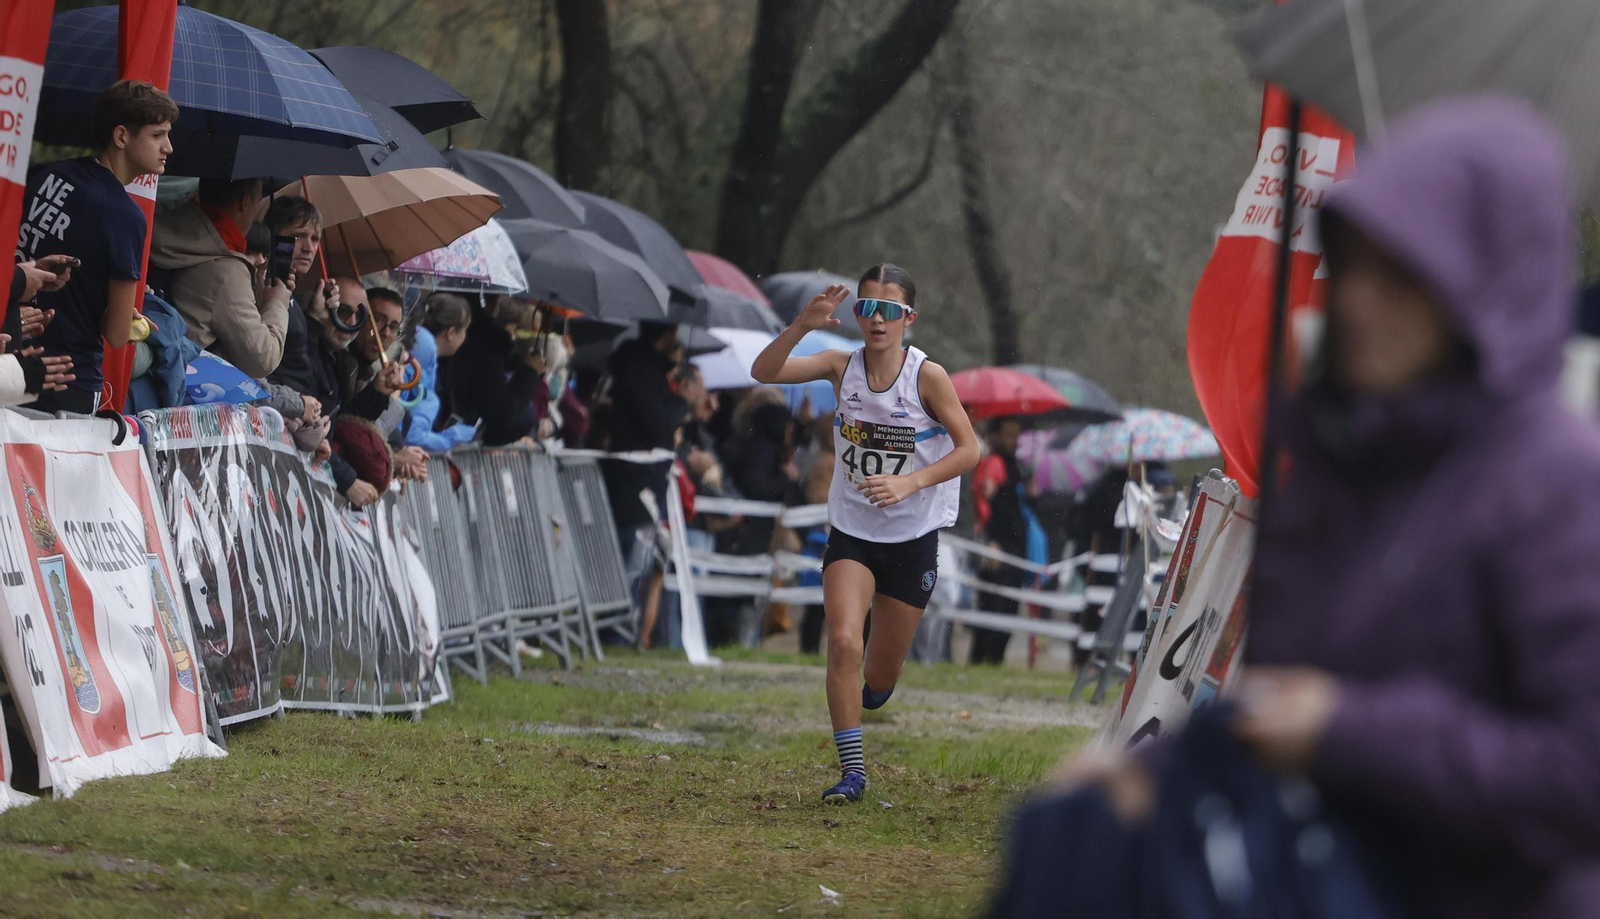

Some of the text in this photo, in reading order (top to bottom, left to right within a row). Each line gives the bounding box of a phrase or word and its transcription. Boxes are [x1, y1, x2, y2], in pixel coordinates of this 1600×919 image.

[37, 173, 75, 208] NE
[27, 196, 71, 241] VER
[17, 222, 46, 255] ST
[873, 432, 916, 442] BELARMINO
[877, 426, 915, 435] MEMORIAL
[884, 440, 914, 450] ALONSO
[841, 444, 907, 477] 407
